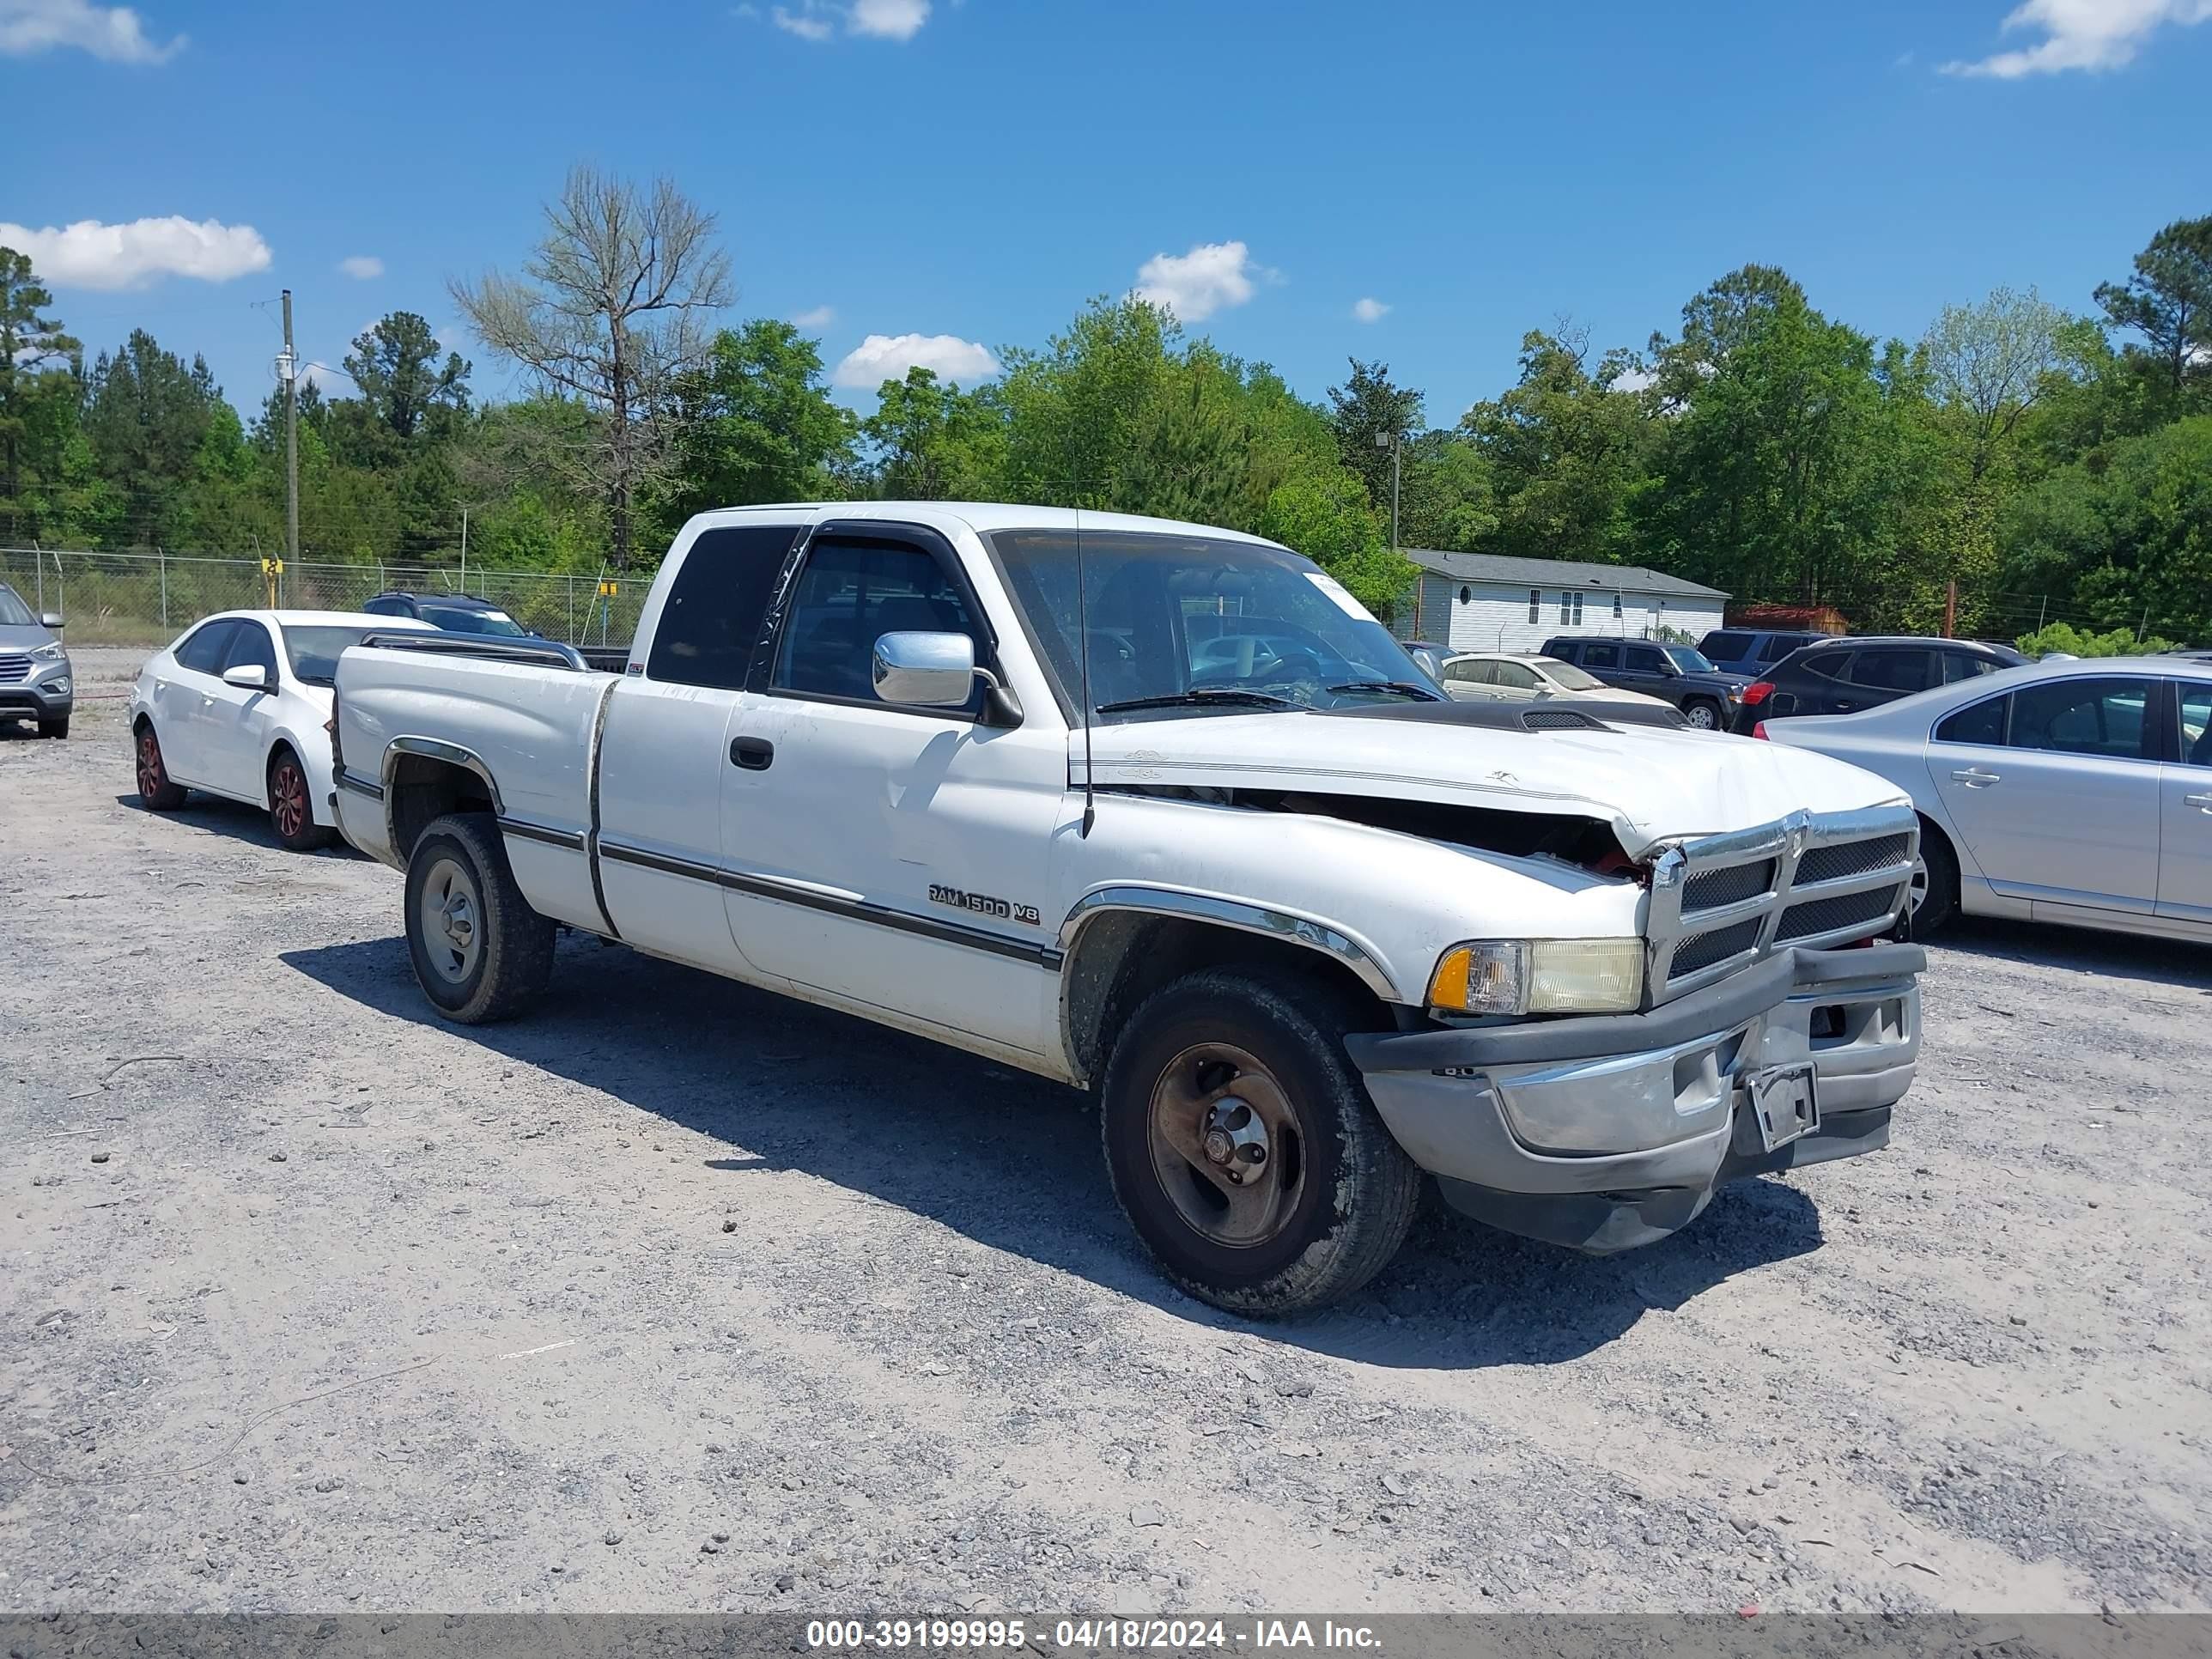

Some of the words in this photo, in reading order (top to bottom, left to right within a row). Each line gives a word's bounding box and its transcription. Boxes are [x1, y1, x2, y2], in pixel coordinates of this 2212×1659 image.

[928, 884, 962, 906] RAM
[964, 894, 1009, 918] 1500
[1014, 904, 1039, 921] V8
